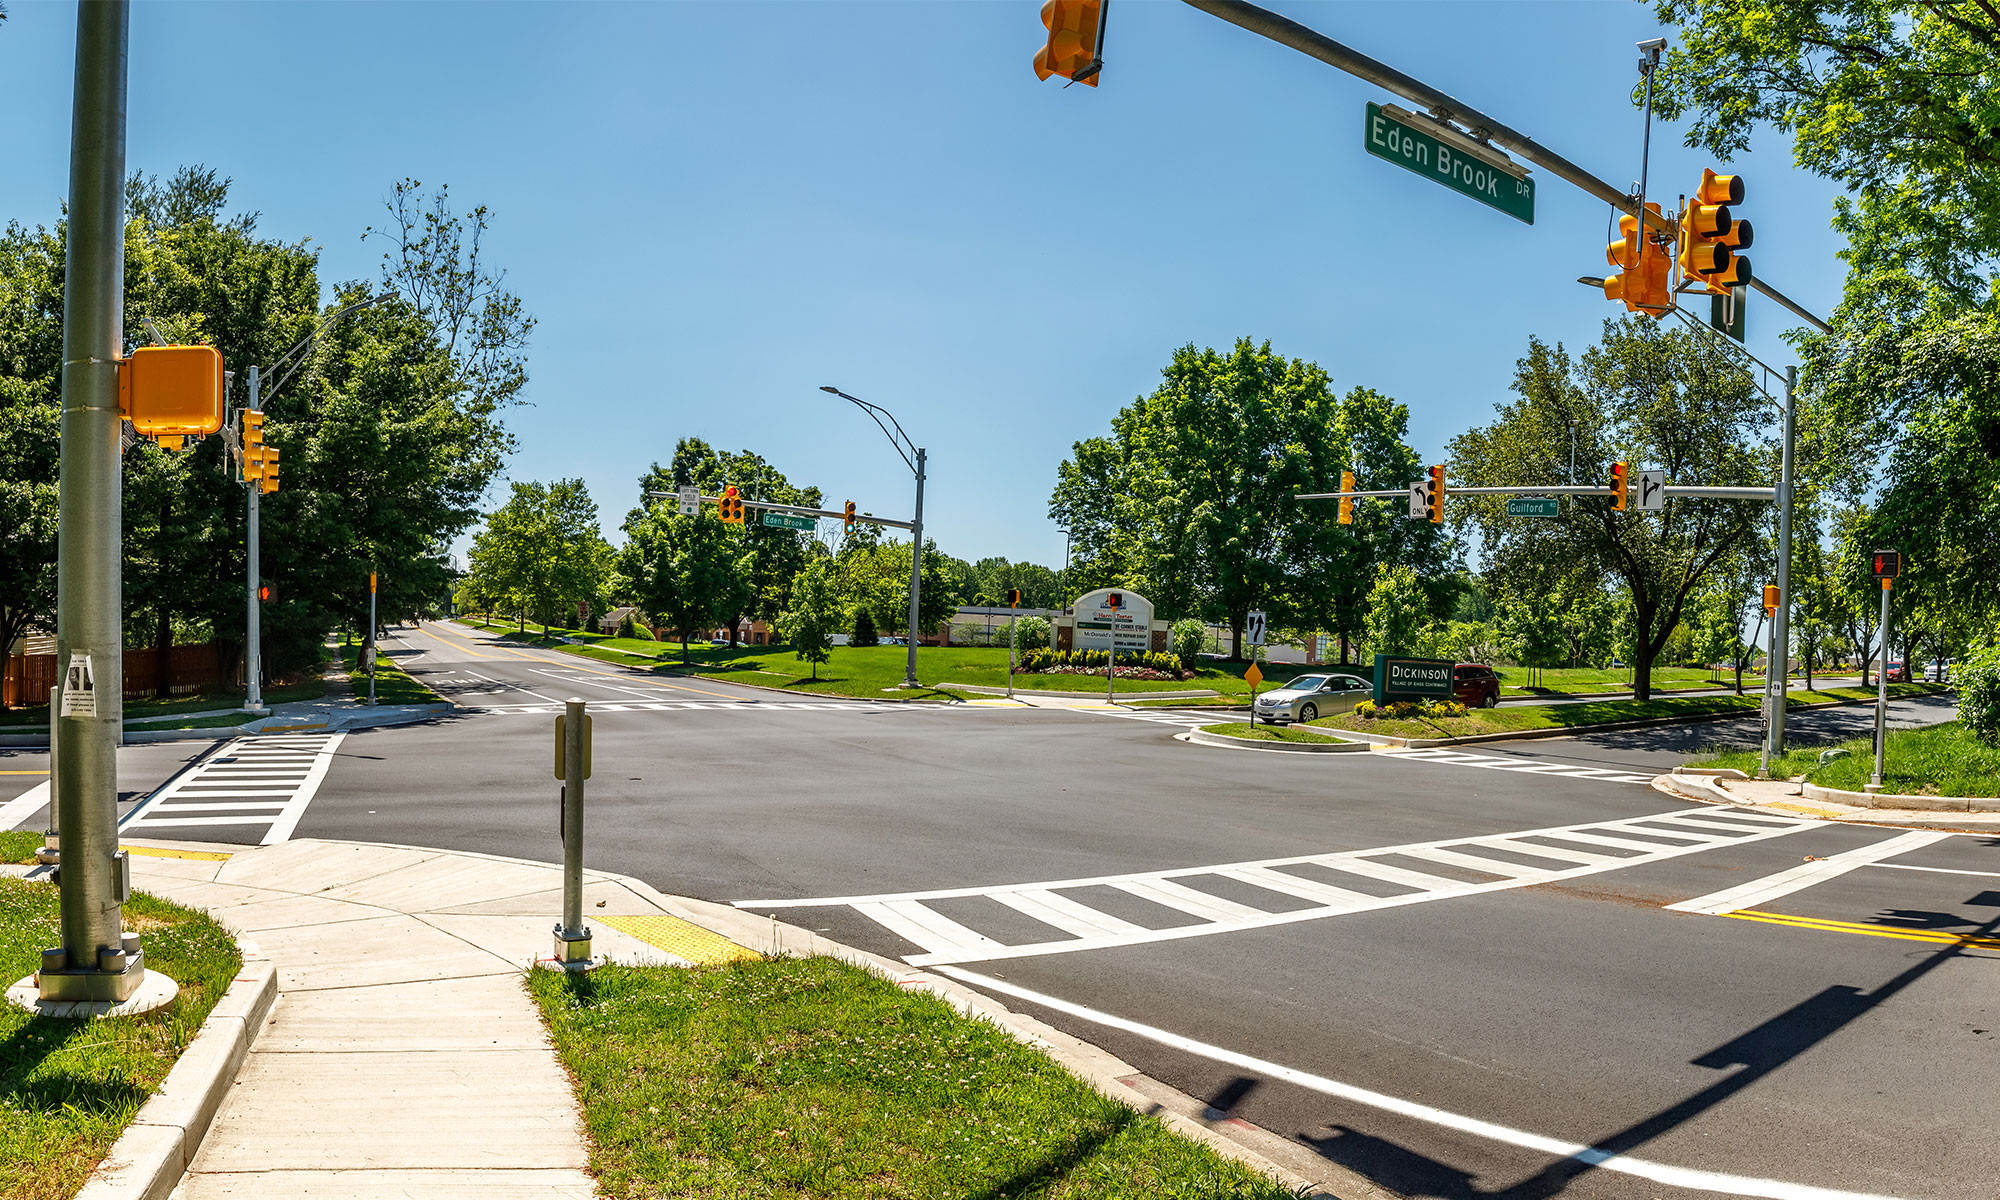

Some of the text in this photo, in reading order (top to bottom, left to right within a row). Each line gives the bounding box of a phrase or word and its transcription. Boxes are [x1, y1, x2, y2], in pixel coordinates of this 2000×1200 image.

[1372, 116, 1530, 199] Eden Brook DR
[1510, 502, 1543, 512] Guilford
[766, 516, 781, 524] Eden
[784, 518, 802, 527] Brook
